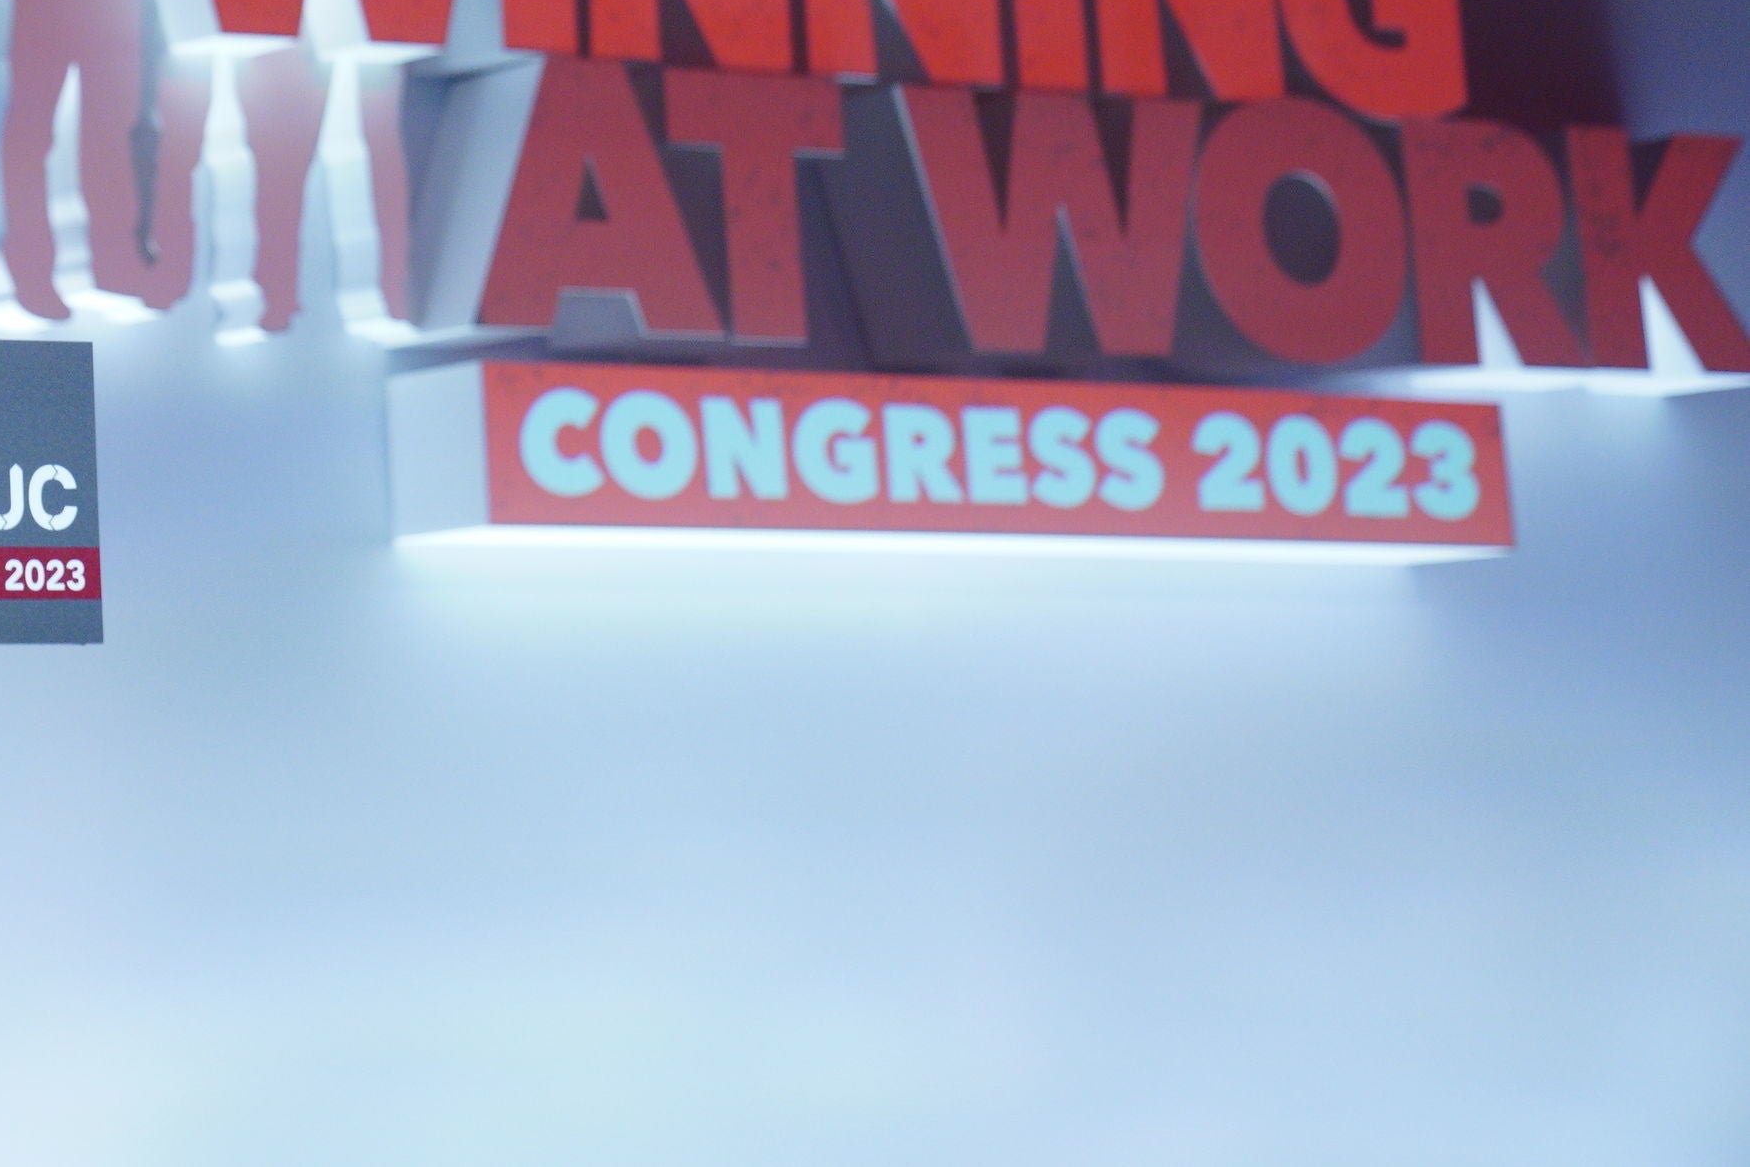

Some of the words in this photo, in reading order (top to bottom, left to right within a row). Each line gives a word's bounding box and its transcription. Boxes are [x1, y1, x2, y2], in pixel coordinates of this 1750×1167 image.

[478, 55, 847, 346] AT
[895, 82, 1750, 372] WORK
[519, 388, 1164, 510] CONGRESS
[1192, 414, 1481, 520] 2023
[4, 557, 86, 592] 2023
